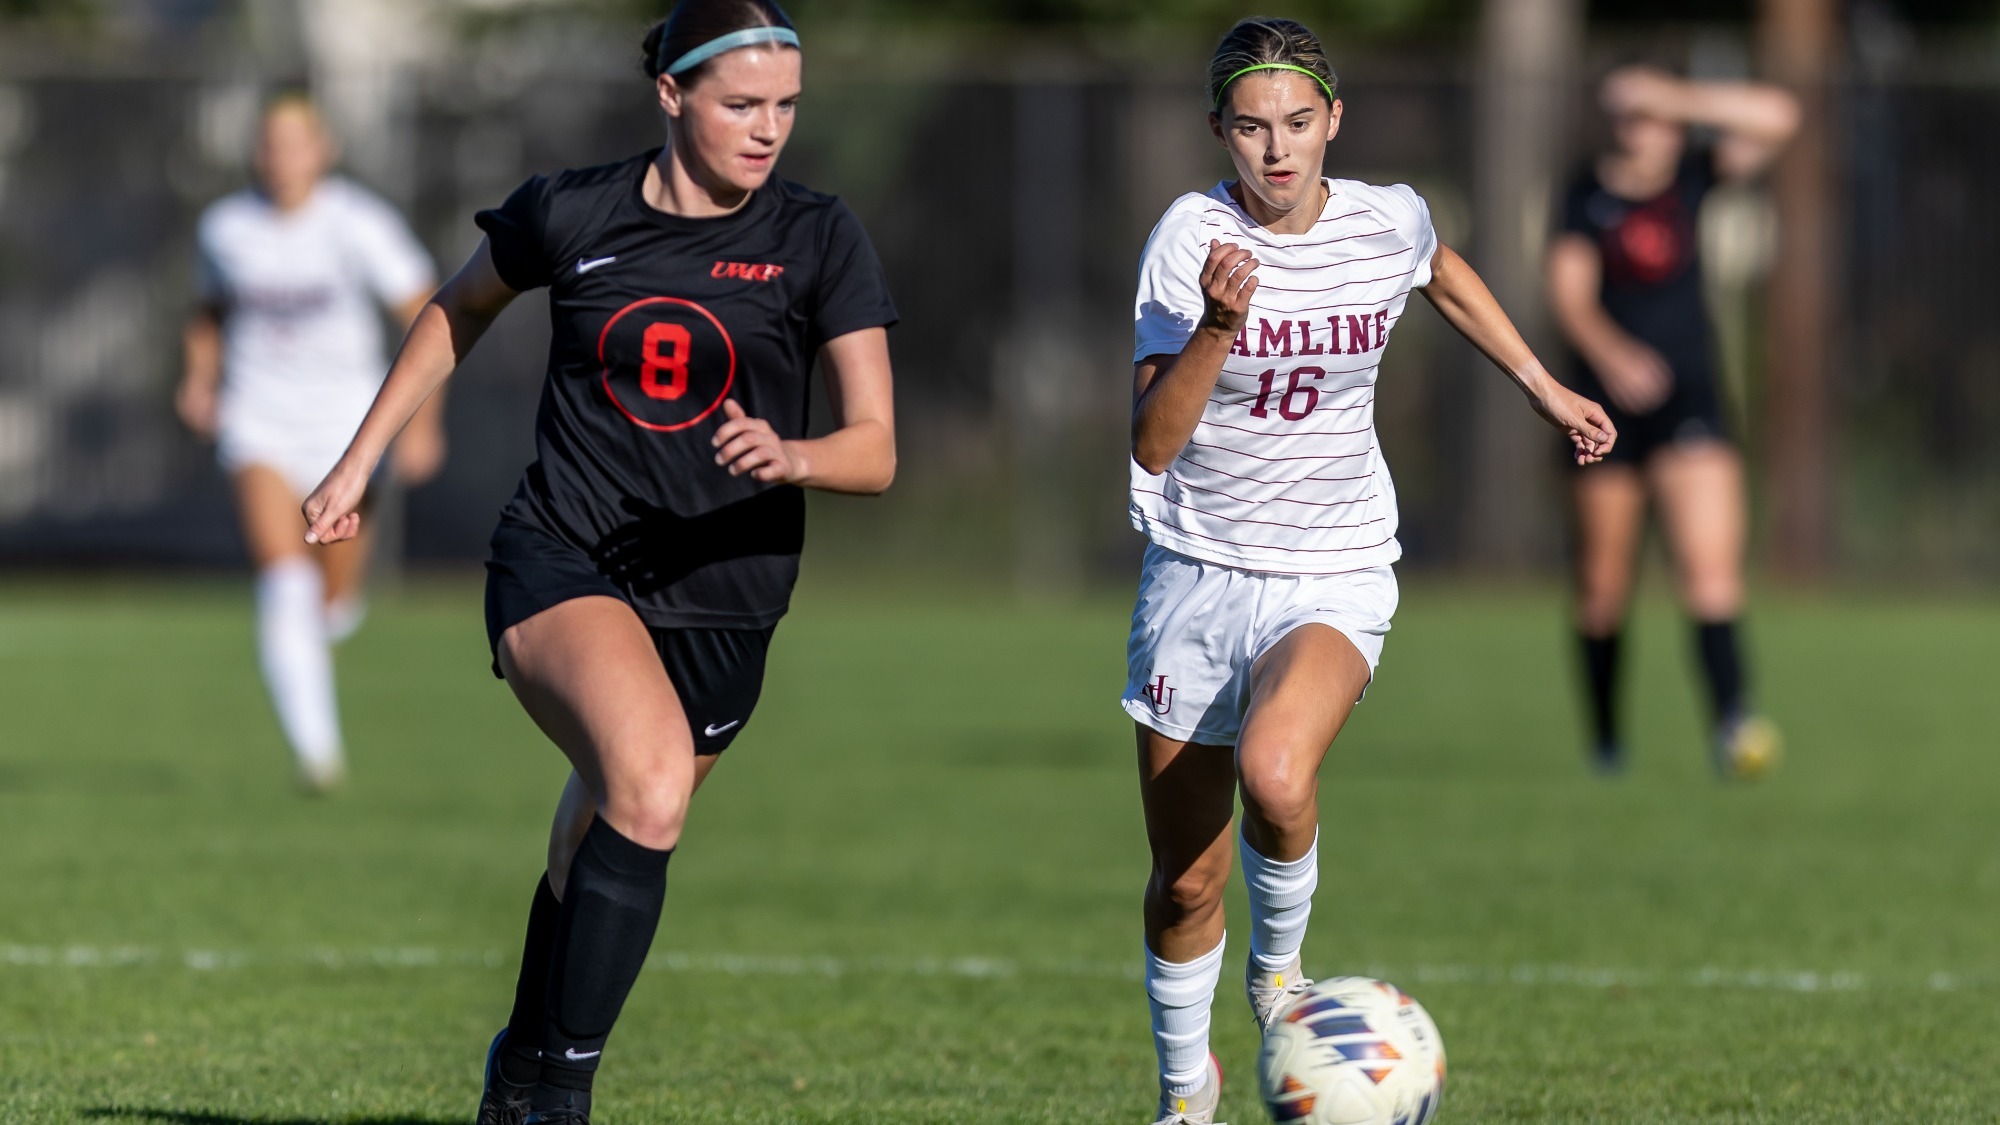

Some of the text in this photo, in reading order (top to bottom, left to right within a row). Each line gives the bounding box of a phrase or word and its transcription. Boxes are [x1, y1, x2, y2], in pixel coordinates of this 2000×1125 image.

[1229, 308, 1389, 358] AMLINE
[641, 322, 691, 400] 8
[1250, 366, 1326, 421] 16
